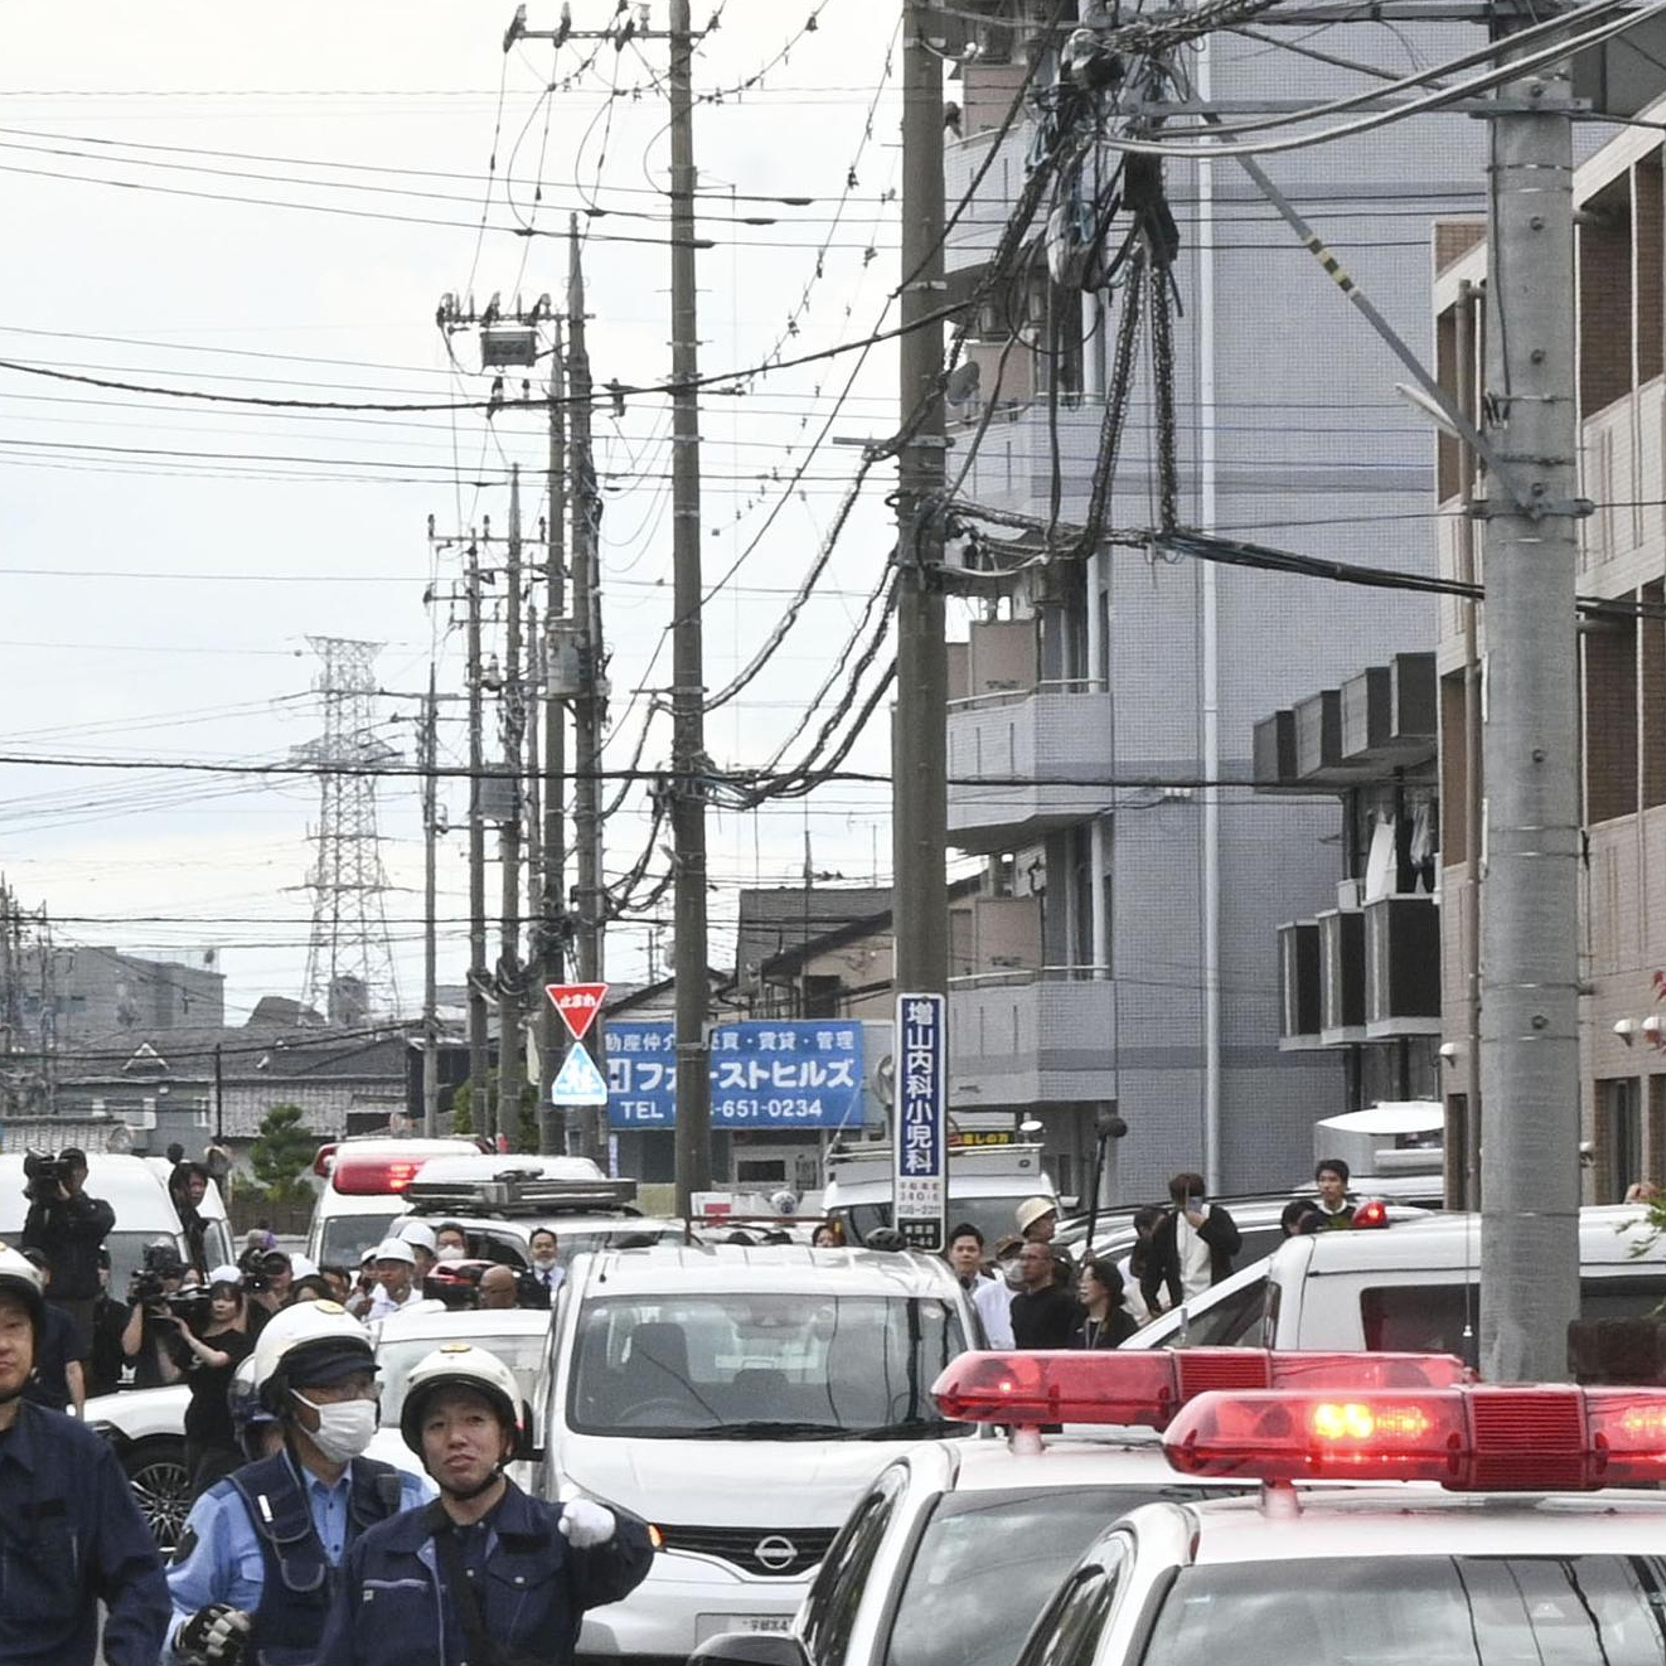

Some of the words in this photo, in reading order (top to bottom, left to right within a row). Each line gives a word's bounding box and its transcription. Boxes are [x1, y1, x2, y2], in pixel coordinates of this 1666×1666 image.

[560, 993, 596, 1009] 止まれ
[905, 1001, 934, 1175] 増山内科小児科
[620, 1101, 665, 1119] TEL
